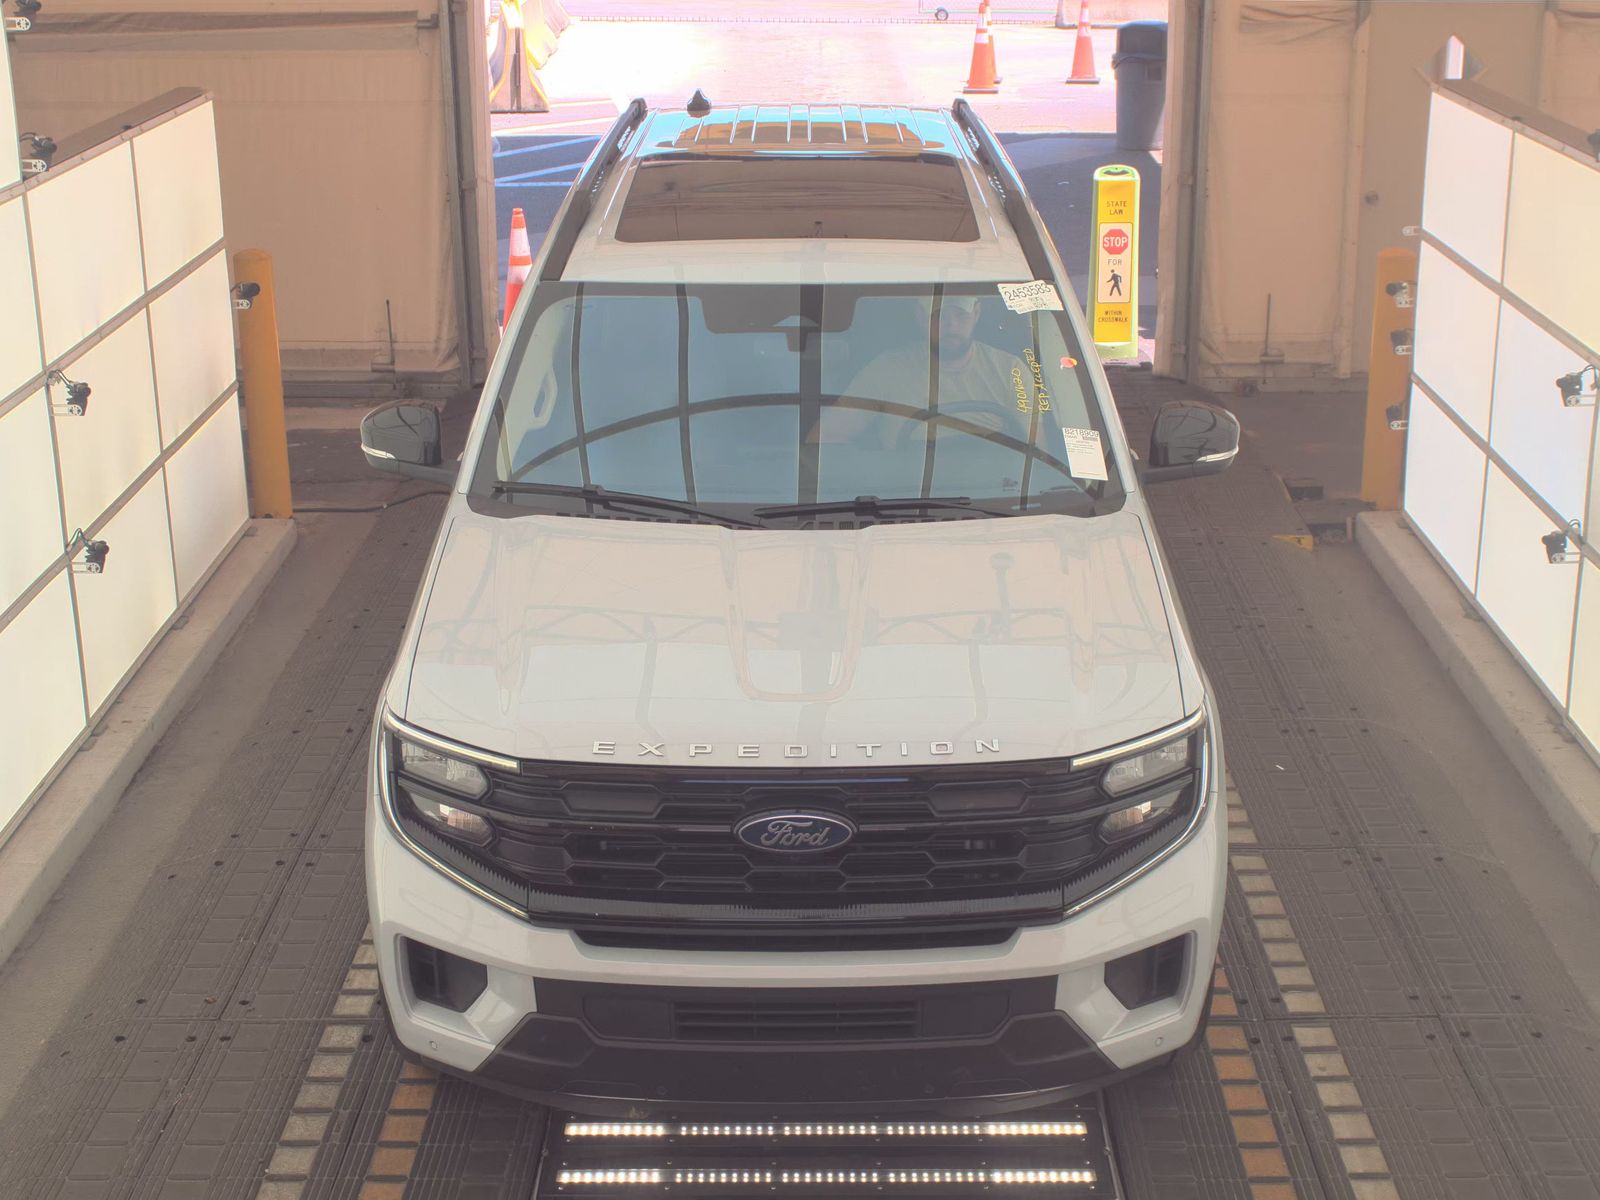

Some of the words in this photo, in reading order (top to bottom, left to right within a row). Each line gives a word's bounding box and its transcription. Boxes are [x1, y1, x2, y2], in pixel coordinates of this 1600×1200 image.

[1106, 200, 1128, 208] STATE
[1109, 208, 1124, 216] LAW
[1103, 236, 1128, 248] STOP
[1107, 258, 1122, 266] FOR
[1004, 283, 1051, 301] 2453583
[592, 738, 1001, 758] EXPEDITION
[760, 819, 830, 847] Ford
